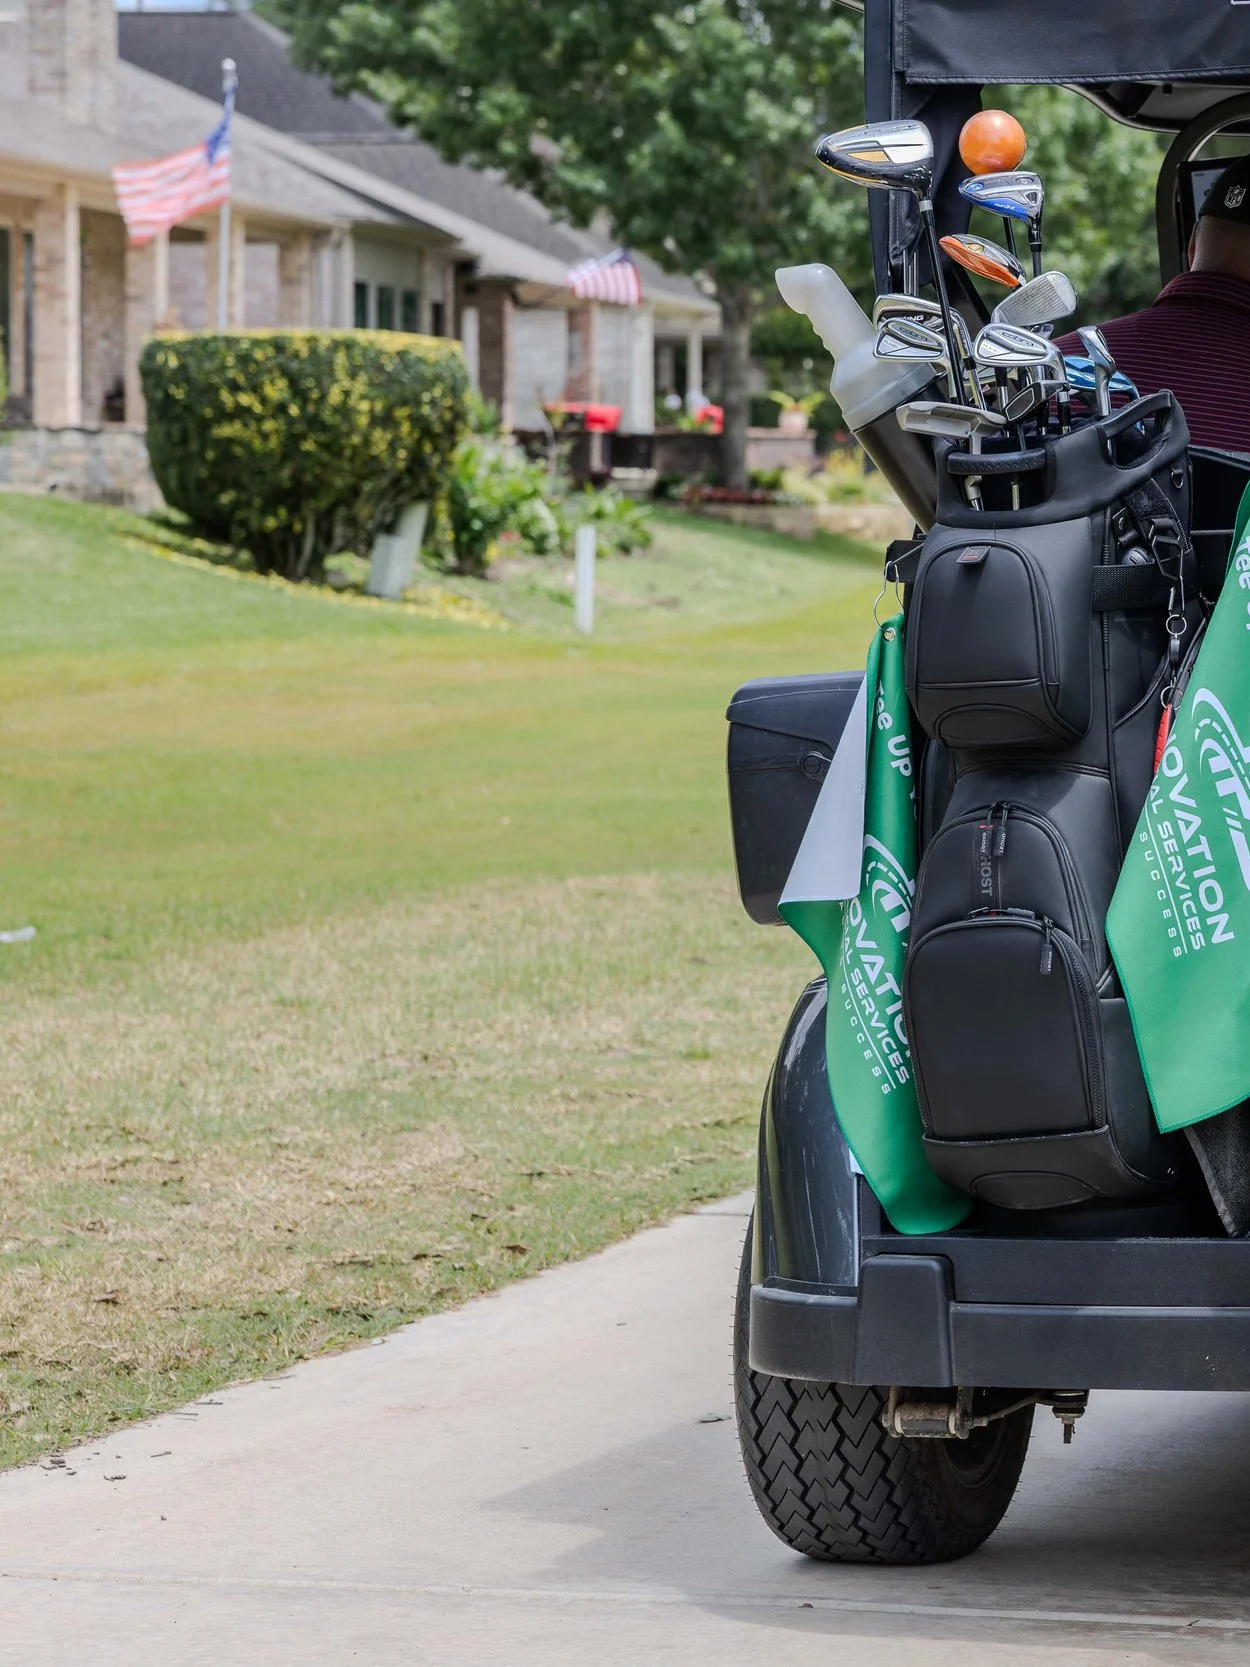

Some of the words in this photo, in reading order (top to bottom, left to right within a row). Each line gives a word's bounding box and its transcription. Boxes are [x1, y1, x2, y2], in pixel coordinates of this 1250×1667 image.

[887, 734, 912, 777] Up
[981, 856, 992, 896] HOST
[1139, 831, 1182, 957] SUCCESS
[1157, 821, 1205, 950] SERVICES
[1162, 734, 1235, 944] OVATION
[841, 983, 890, 1095] SUCCESS
[851, 967, 909, 1084] SERVICES
